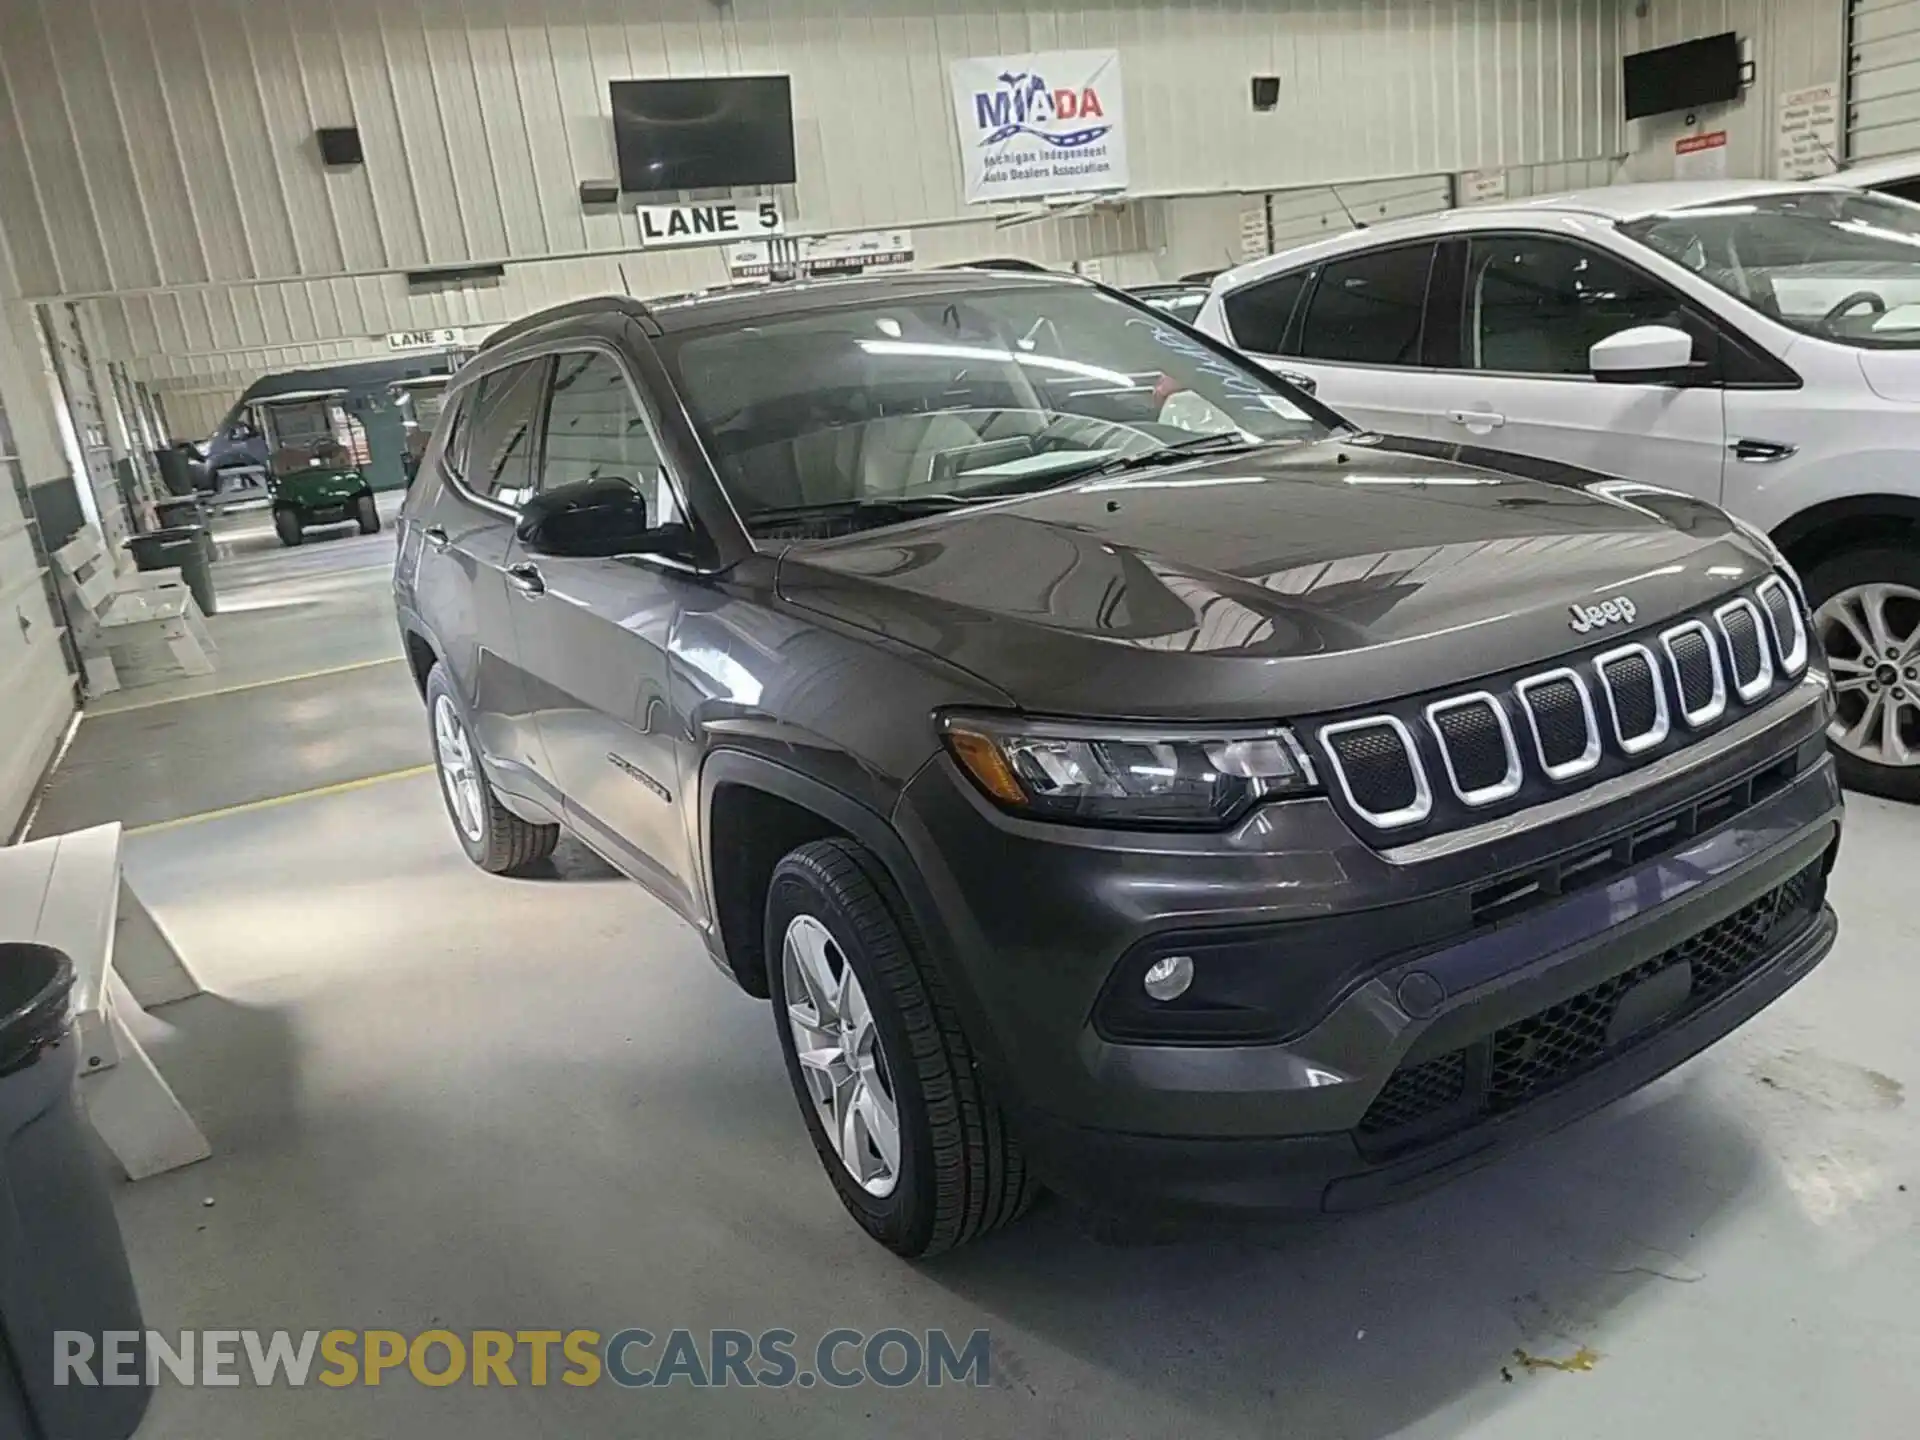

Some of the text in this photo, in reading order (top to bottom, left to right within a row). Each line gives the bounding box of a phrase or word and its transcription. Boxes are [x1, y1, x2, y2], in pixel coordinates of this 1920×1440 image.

[983, 162, 1111, 183] Auto Dealers Association
[642, 203, 780, 238] LANE 5
[390, 331, 455, 347] LANE 3
[1569, 596, 1637, 634] Jeep
